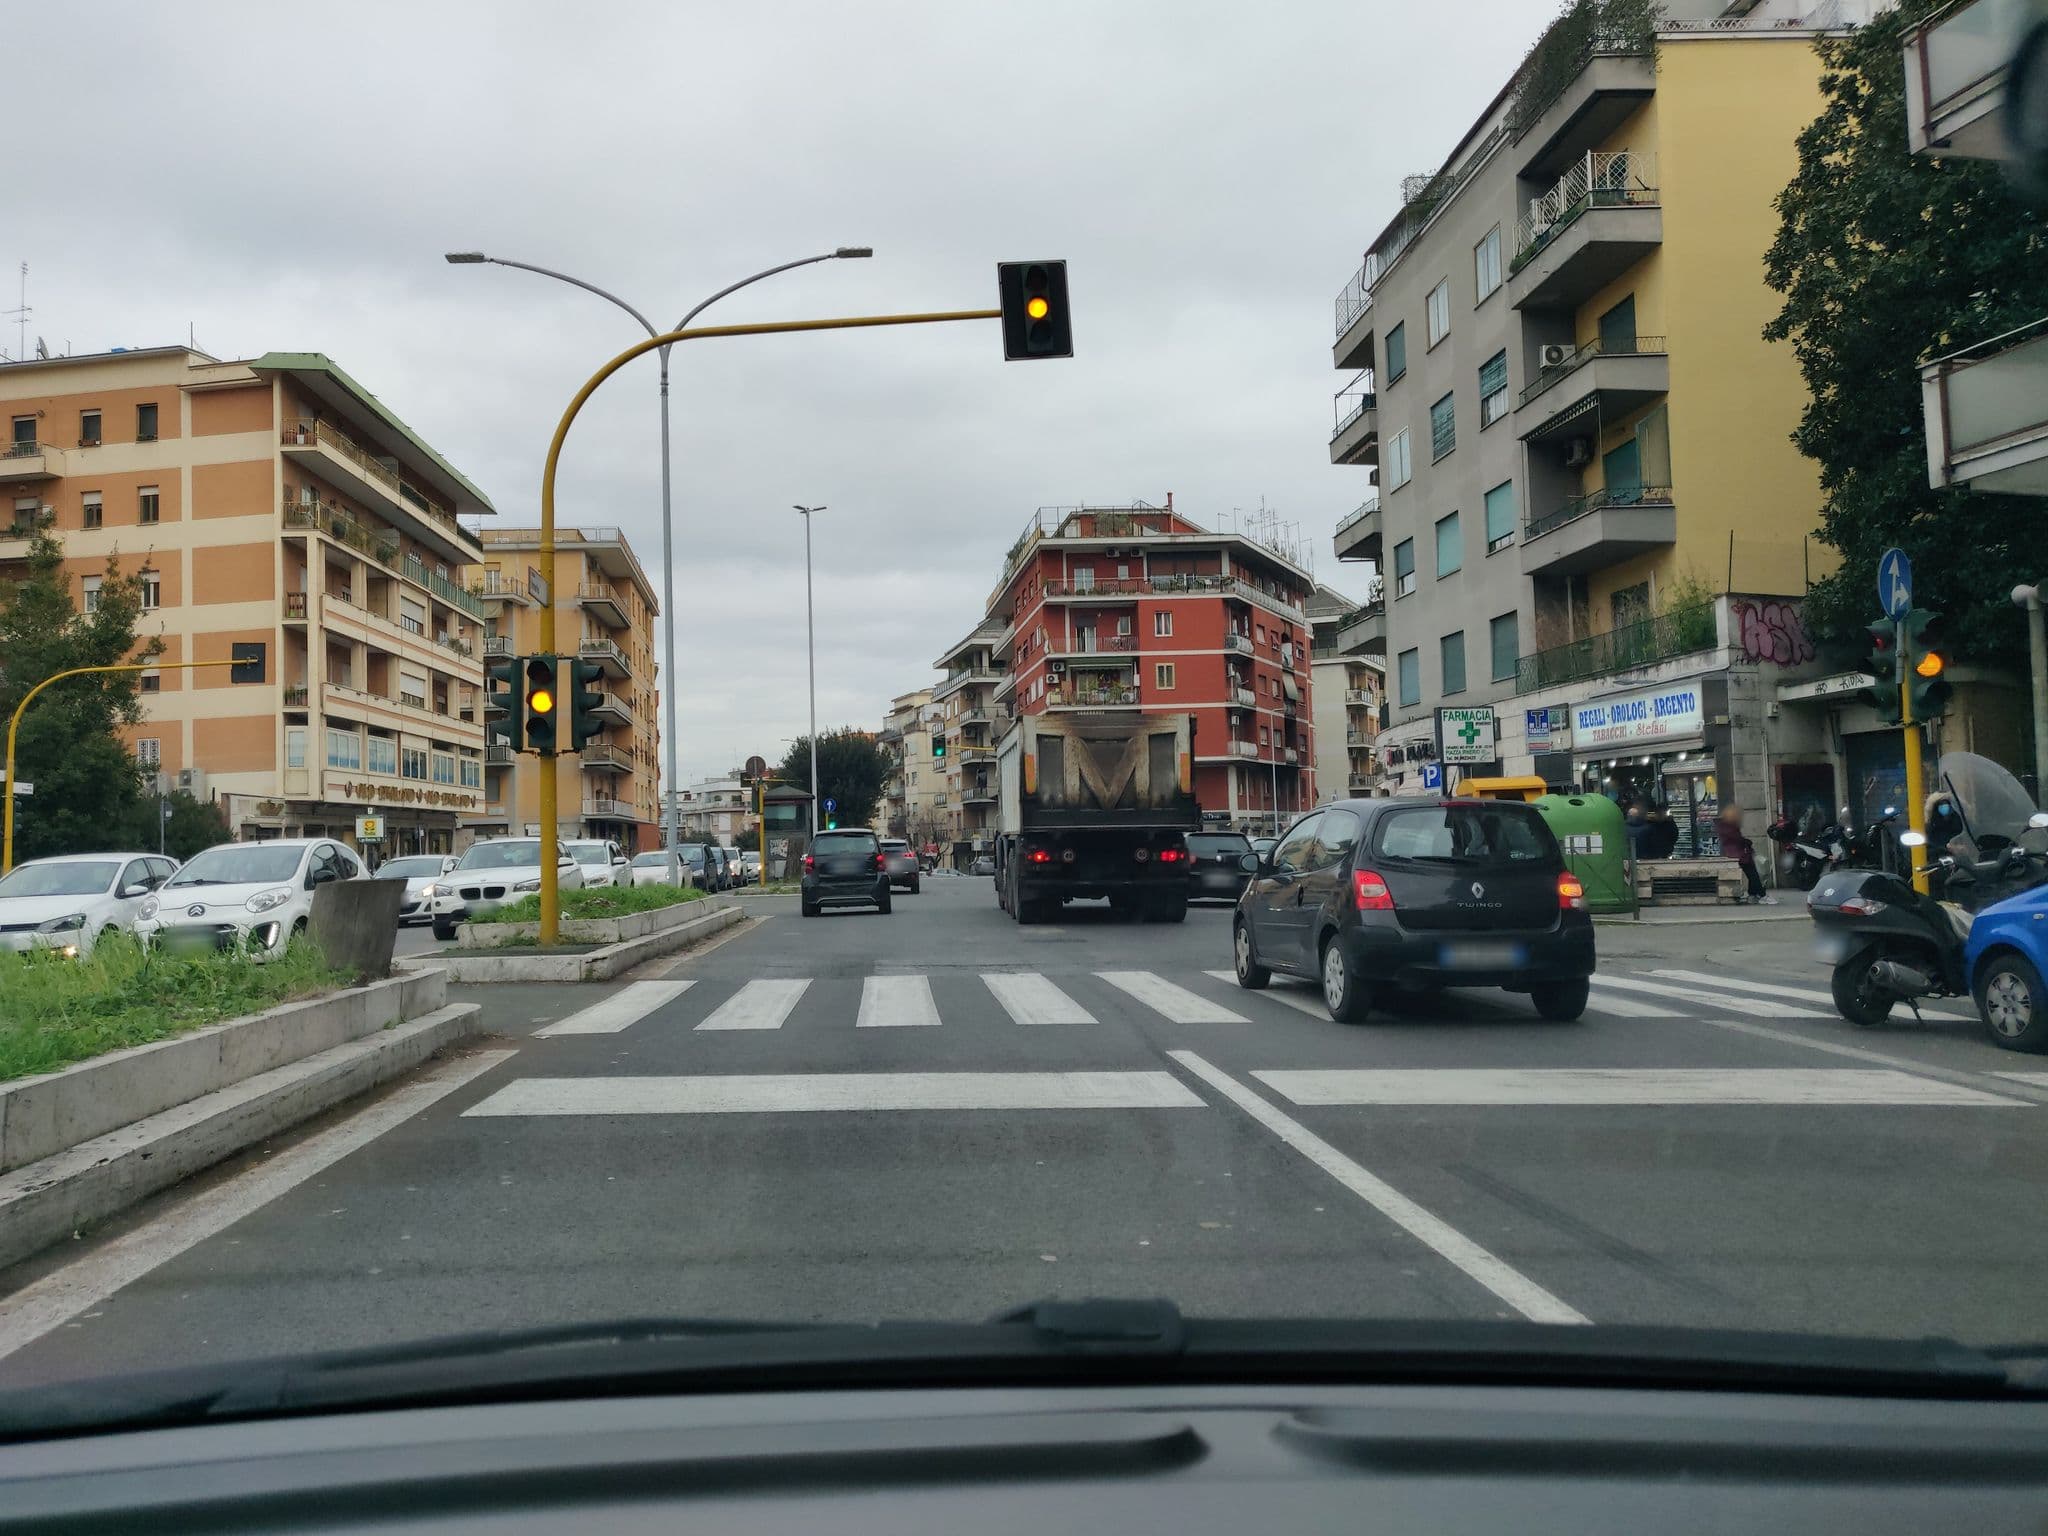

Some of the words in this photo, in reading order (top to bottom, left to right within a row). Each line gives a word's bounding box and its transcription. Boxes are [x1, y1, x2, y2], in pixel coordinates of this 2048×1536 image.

[1443, 710, 1491, 721] FARMACIA
[1579, 708, 1606, 729] REGALI
[1611, 700, 1647, 724] OROLOGI
[1654, 692, 1695, 718] ARGENTO
[1592, 725, 1627, 743] TABACCHI
[1636, 720, 1667, 736] Stefani
[1425, 766, 1438, 786] P
